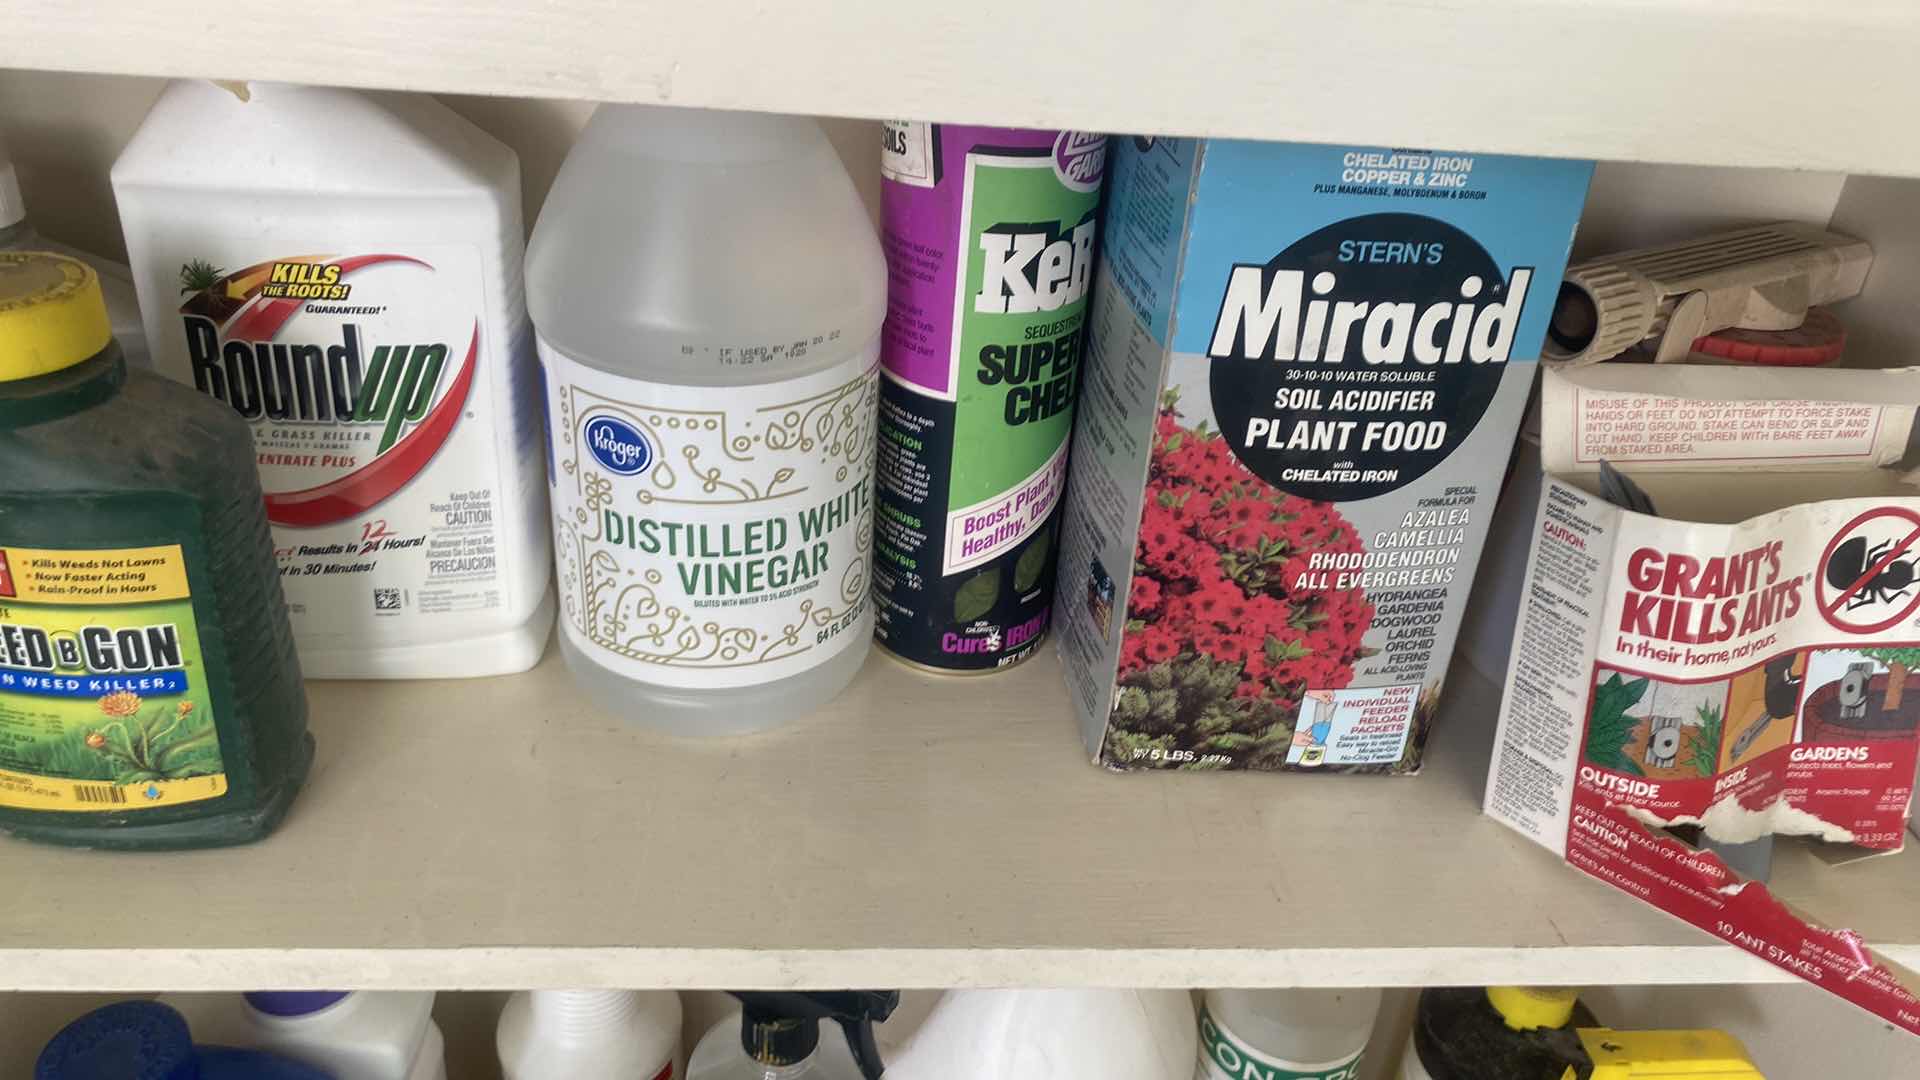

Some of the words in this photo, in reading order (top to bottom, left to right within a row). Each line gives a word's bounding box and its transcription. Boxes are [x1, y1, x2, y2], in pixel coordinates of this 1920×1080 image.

[1344, 152, 1430, 171] CHELATED
[1432, 157, 1473, 172] IRON
[1342, 169, 1412, 185] COPPER
[1413, 173, 1425, 186] &
[1428, 174, 1468, 188] ZINC
[1314, 184, 1336, 193] PLUS
[1393, 188, 1449, 199] MOLYBDENUM
[1458, 191, 1487, 200] BORON
[1337, 240, 1444, 265] STERN'S
[271, 263, 341, 284] KILLS
[263, 286, 285, 297] THE
[286, 285, 350, 299] ROOTS!
[1207, 263, 1534, 366] Miracid
[740, 346, 768, 357] USED
[773, 344, 785, 354] BY
[812, 335, 824, 345] 20
[1285, 370, 1334, 381] 30-10-10
[1335, 370, 1379, 382] WATER
[1379, 370, 1437, 382] SOLUBLE
[183, 315, 450, 457] Roundup
[1274, 388, 1326, 410] SOIL
[1328, 389, 1436, 412] ACIDIFIER
[1585, 399, 1629, 409] MISUSE
[1632, 399, 1649, 409] OF
[1654, 399, 1679, 408] THIS
[1585, 410, 1625, 421] HANDS
[1626, 410, 1643, 420] OR
[1679, 409, 1696, 420] DO
[1698, 409, 1722, 419] NOT
[1724, 408, 1776, 419] ATTEMPT
[1778, 408, 1794, 418] TO
[1796, 407, 1833, 417] FORCE
[1836, 407, 1872, 417] STAKE
[1585, 422, 1613, 432] INTO
[1615, 422, 1646, 432] HARD
[1703, 420, 1741, 431] STAKE
[1743, 420, 1765, 430] CAN
[1767, 419, 1798, 430] BEND
[1801, 419, 1817, 429] OR
[1820, 418, 1845, 428] SLIP
[1845, 418, 1870, 428] AND
[271, 430, 316, 440] GRASS
[323, 431, 371, 441] KILLER
[1244, 418, 1358, 451] PLANT
[1361, 420, 1448, 452] FOOD
[1585, 433, 1609, 444] CUT
[1648, 432, 1679, 443] KEEP
[1681, 431, 1738, 442] CHILDREN
[1741, 430, 1770, 441] WITH
[1773, 430, 1802, 440] BARE
[1805, 429, 1834, 440] FEET
[1835, 429, 1869, 439] AWAY
[595, 425, 641, 466] Kroger
[1585, 445, 1618, 455] FROM
[1619, 444, 1663, 454] STAKED
[1333, 459, 1354, 470] with
[1282, 468, 1361, 483] CHELATED
[1362, 469, 1399, 483] IRON
[1444, 486, 1478, 497] SPECIAL
[963, 501, 1012, 537] Boost
[1014, 470, 1050, 513] Plant
[1417, 497, 1455, 509] FORMULA
[1455, 495, 1477, 507] FOR
[445, 509, 492, 526] CAUTION
[604, 508, 788, 558] DISTILLED
[798, 474, 871, 543] WHITE
[1401, 508, 1471, 529] AZALEA
[298, 543, 344, 557] Results
[345, 543, 359, 553] in
[382, 534, 427, 551] Hours!
[961, 517, 1027, 558] Healthy,
[1374, 528, 1465, 549] CAMELLIA
[31, 559, 57, 569] Kills
[59, 559, 100, 569] Weeds
[100, 558, 125, 568] Not
[126, 556, 166, 567] Lawns
[1308, 547, 1460, 571] RHODODENDRON
[34, 572, 63, 582] Now
[64, 571, 103, 582] Faster
[105, 571, 146, 582] Acting
[289, 565, 301, 576] in
[303, 563, 322, 576] 30
[323, 560, 377, 575] Minutes!
[677, 540, 830, 596] VINEGAR
[1627, 540, 1783, 599] GRANT'S
[1294, 571, 1329, 590] ALL
[1336, 566, 1456, 590] EVERGREENS
[37, 584, 104, 595] Rain-Proof
[106, 585, 118, 594] in
[120, 583, 157, 594] Hours
[1365, 588, 1448, 603] HYDRANGEA
[722, 598, 738, 607] WITH
[1376, 601, 1444, 616] GARDENIA
[1619, 590, 1740, 645] KILLS
[1738, 575, 1805, 637] ANTS
[1370, 613, 1442, 629] DOGWOOD
[816, 628, 829, 645] 64
[831, 622, 842, 640] FL
[1386, 626, 1437, 641] LAUREL
[81, 622, 184, 673] GON
[1384, 638, 1435, 652] ORCHID
[1616, 636, 1633, 655] In
[1637, 641, 1683, 665] their
[1684, 648, 1730, 666] home,
[1731, 642, 1753, 660] not
[1387, 651, 1431, 665] FERNS
[1363, 667, 1379, 676] ALL
[22, 675, 80, 691] WEED
[89, 677, 166, 692] KILLER
[1343, 696, 1410, 708] INDIVIDUAL
[1362, 705, 1409, 716] FEEDER
[1350, 722, 1405, 734] PACKETS
[1359, 714, 1407, 725] RELOAD
[1151, 748, 1161, 760] 5
[1163, 749, 1198, 761] LBS.
[1790, 747, 1869, 762] GARDENS
[1580, 766, 1660, 799] OUTSIDE
[1714, 767, 1749, 793] INSIDE
[1574, 815, 1629, 850] CAUTION
[1575, 803, 1597, 819] KEEP
[1597, 813, 1616, 829] OUT
[1616, 823, 1629, 836] OF
[1629, 830, 1660, 854] REACH
[1660, 846, 1677, 860] OF
[1676, 853, 1727, 880] CHILDREN
[1599, 864, 1615, 879] Ant
[1615, 872, 1651, 897] Control
[1716, 920, 1734, 937] 10
[1735, 931, 1768, 952] ANT
[1768, 944, 1824, 980] STAKES
